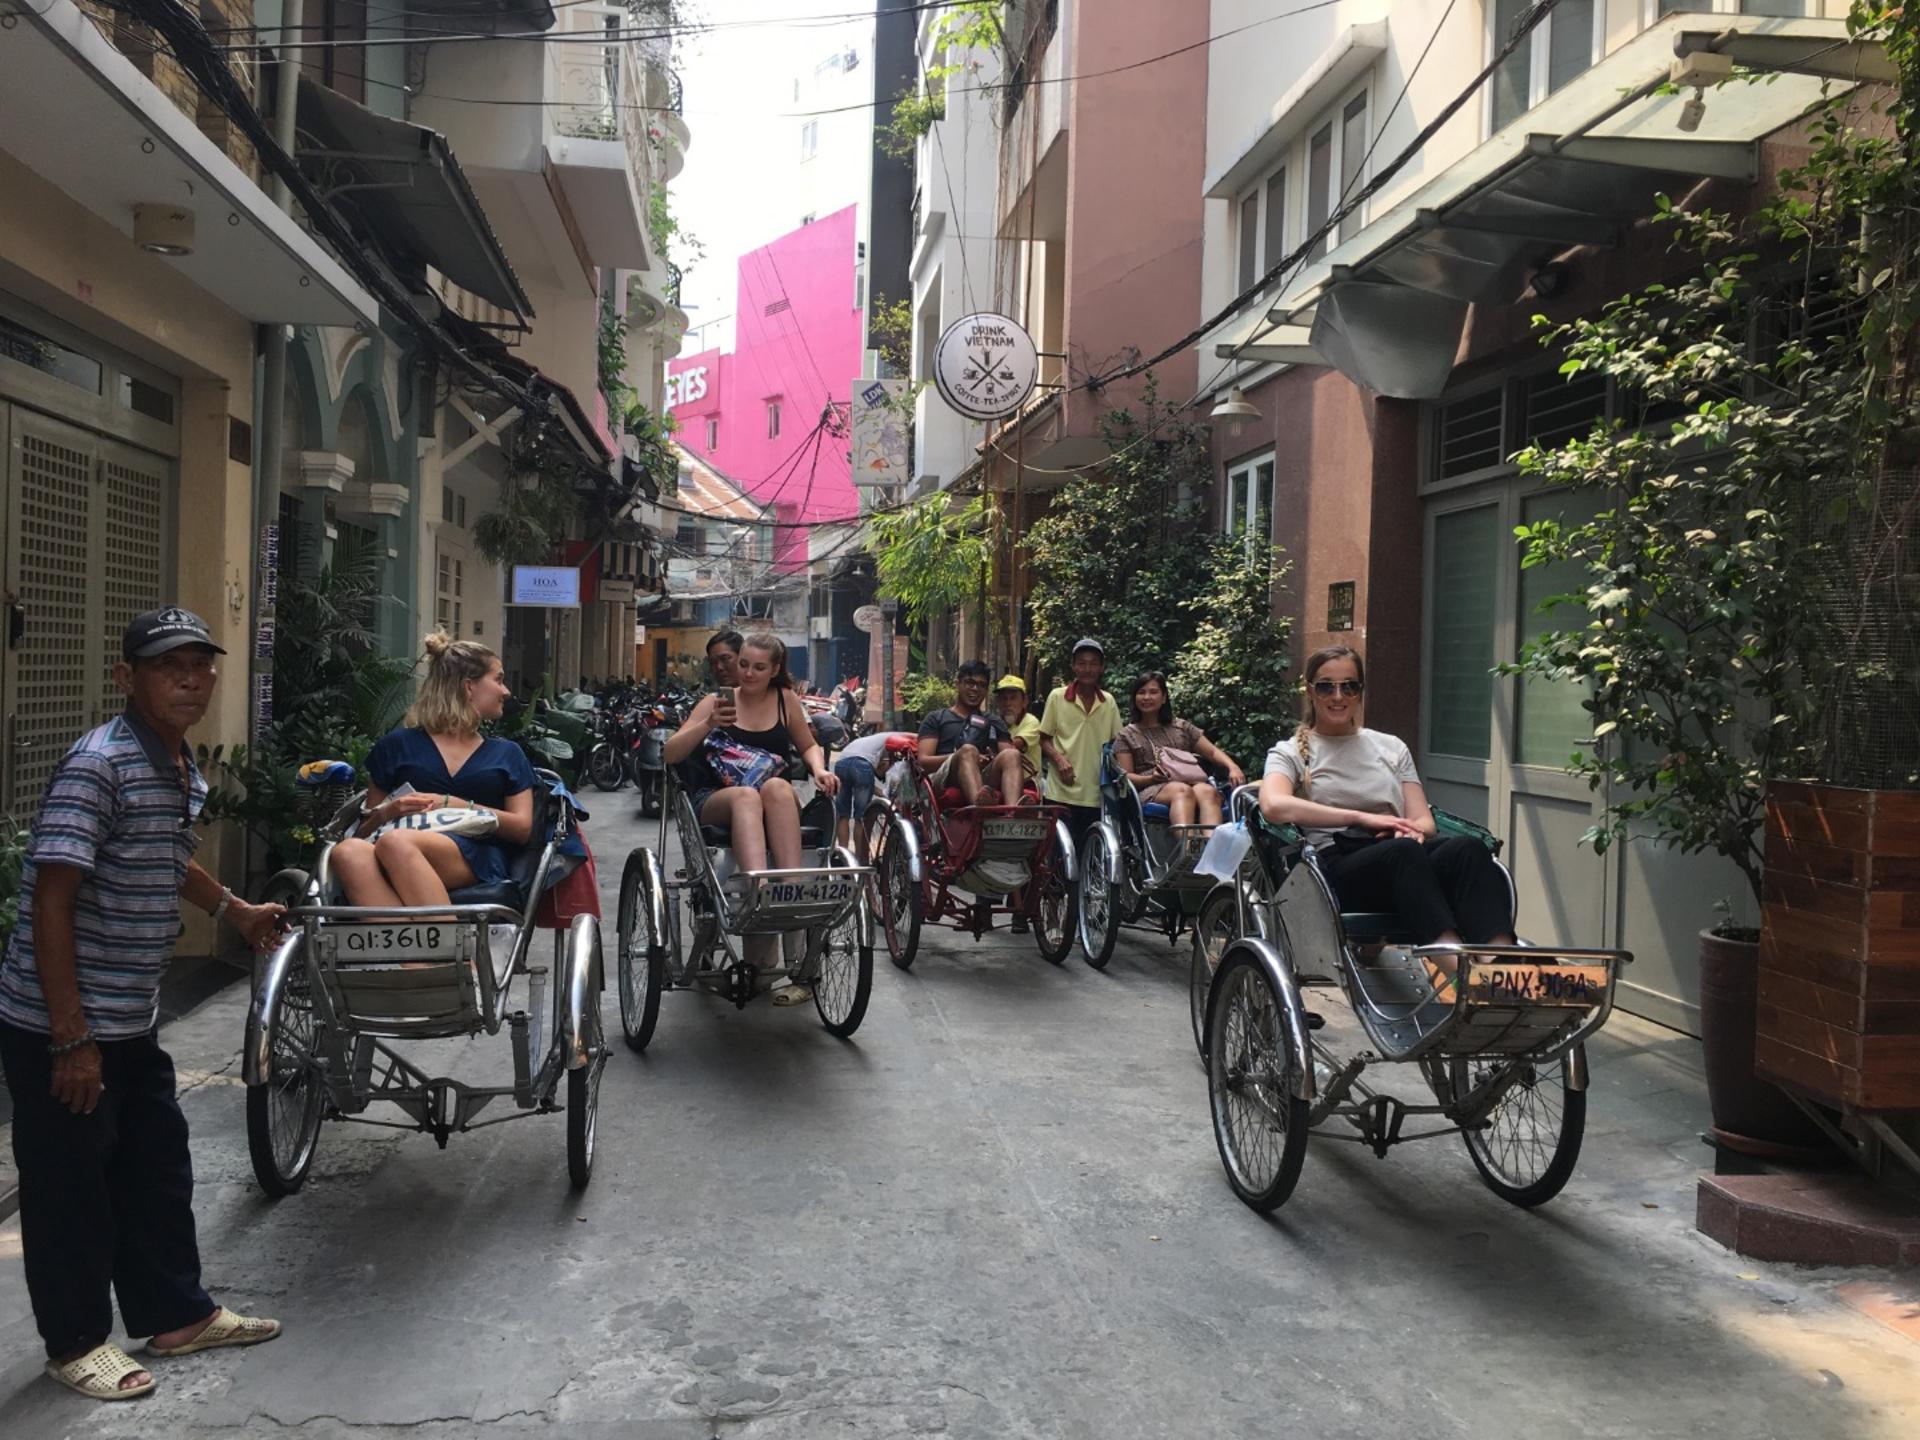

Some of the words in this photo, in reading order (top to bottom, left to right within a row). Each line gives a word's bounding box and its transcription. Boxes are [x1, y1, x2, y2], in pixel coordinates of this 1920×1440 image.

[971, 326, 1007, 336] DRINK
[964, 336, 1015, 348] VIETNAM
[864, 384, 884, 402] LDK
[532, 577, 558, 587] HOA
[771, 883, 848, 902] NBX-412A
